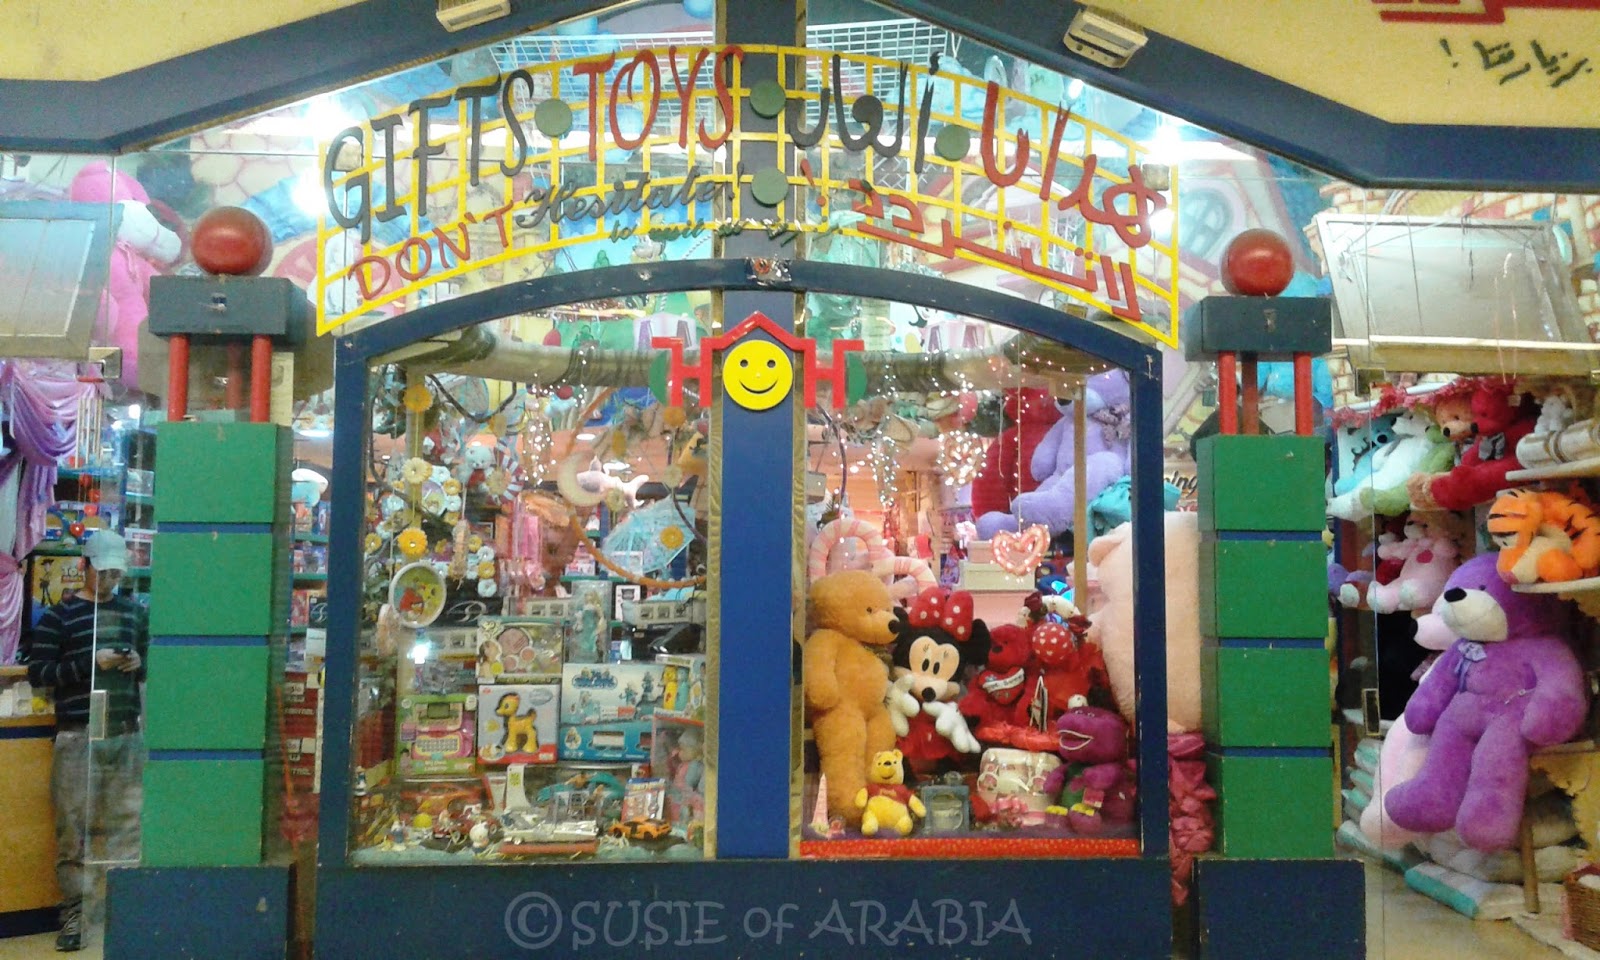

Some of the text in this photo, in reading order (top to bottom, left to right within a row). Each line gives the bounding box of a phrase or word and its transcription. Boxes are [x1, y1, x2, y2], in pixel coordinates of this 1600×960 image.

[324, 45, 744, 245] GIFTS TOYS
[348, 200, 514, 300] DON'T
[609, 219, 638, 243] to
